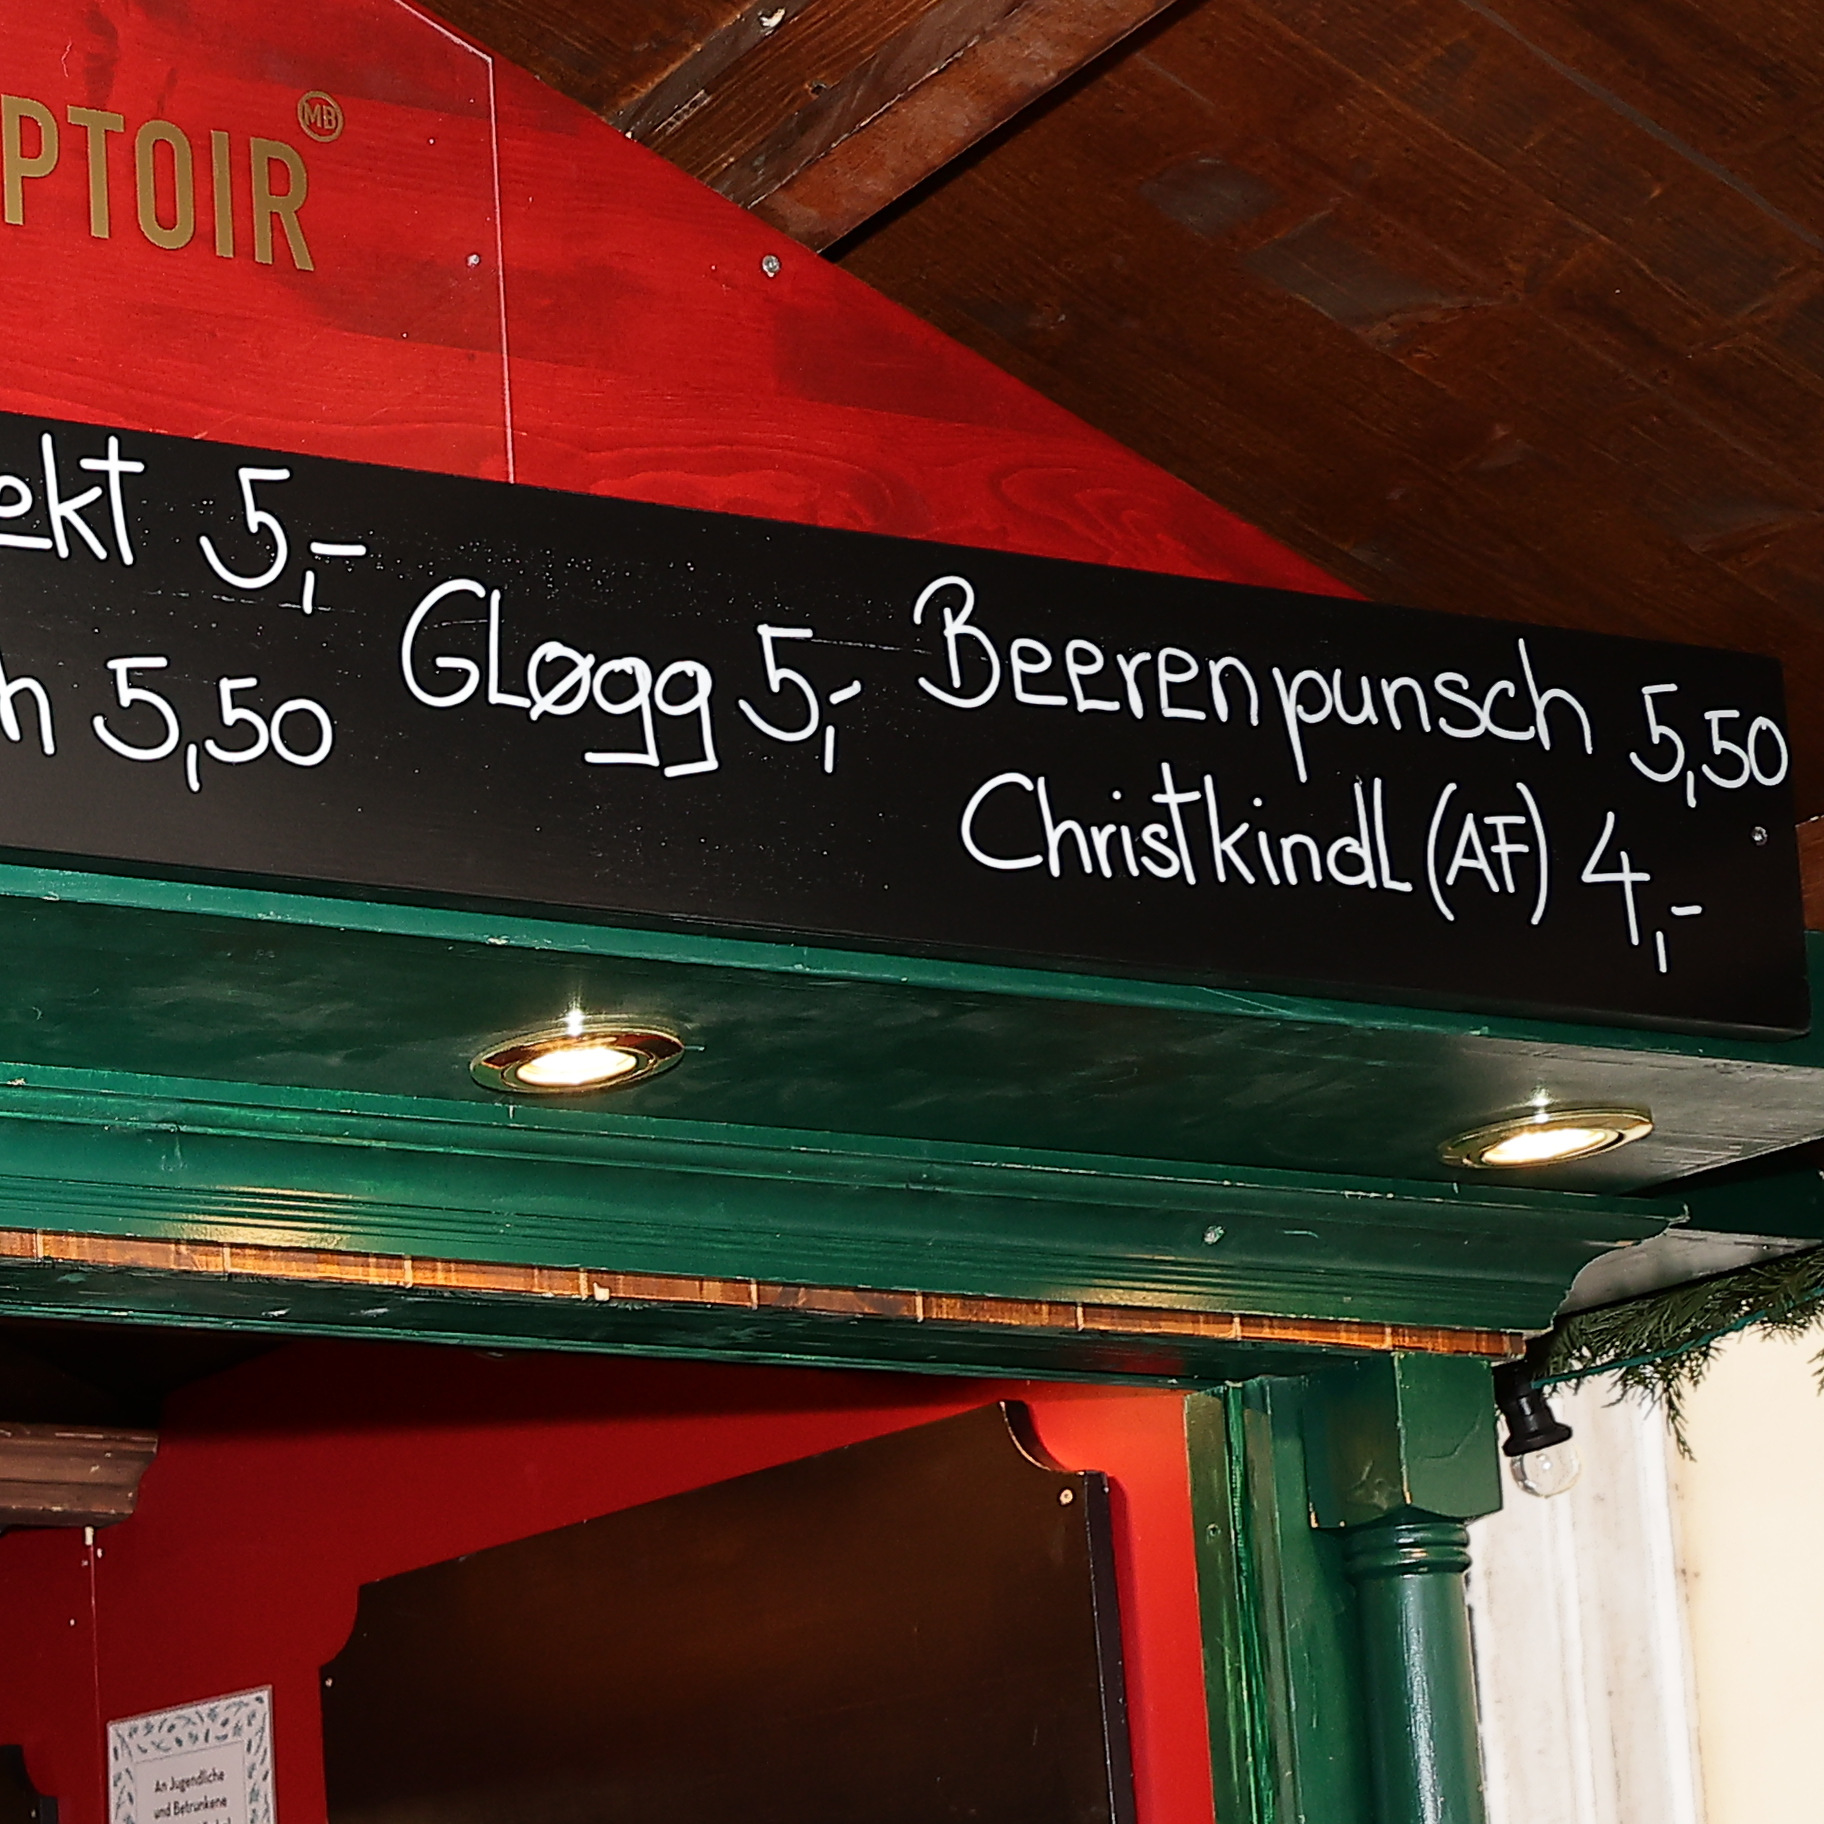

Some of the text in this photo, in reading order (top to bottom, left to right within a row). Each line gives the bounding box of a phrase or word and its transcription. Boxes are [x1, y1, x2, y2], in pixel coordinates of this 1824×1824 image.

[199, 467, 367, 614] 5,-
[93, 657, 334, 791] 5,50
[739, 623, 862, 773] 5,-
[913, 575, 1788, 808] Beerenpunsch 5,50
[1427, 782, 1549, 925] (AF)
[1581, 811, 1705, 973] 4,-
